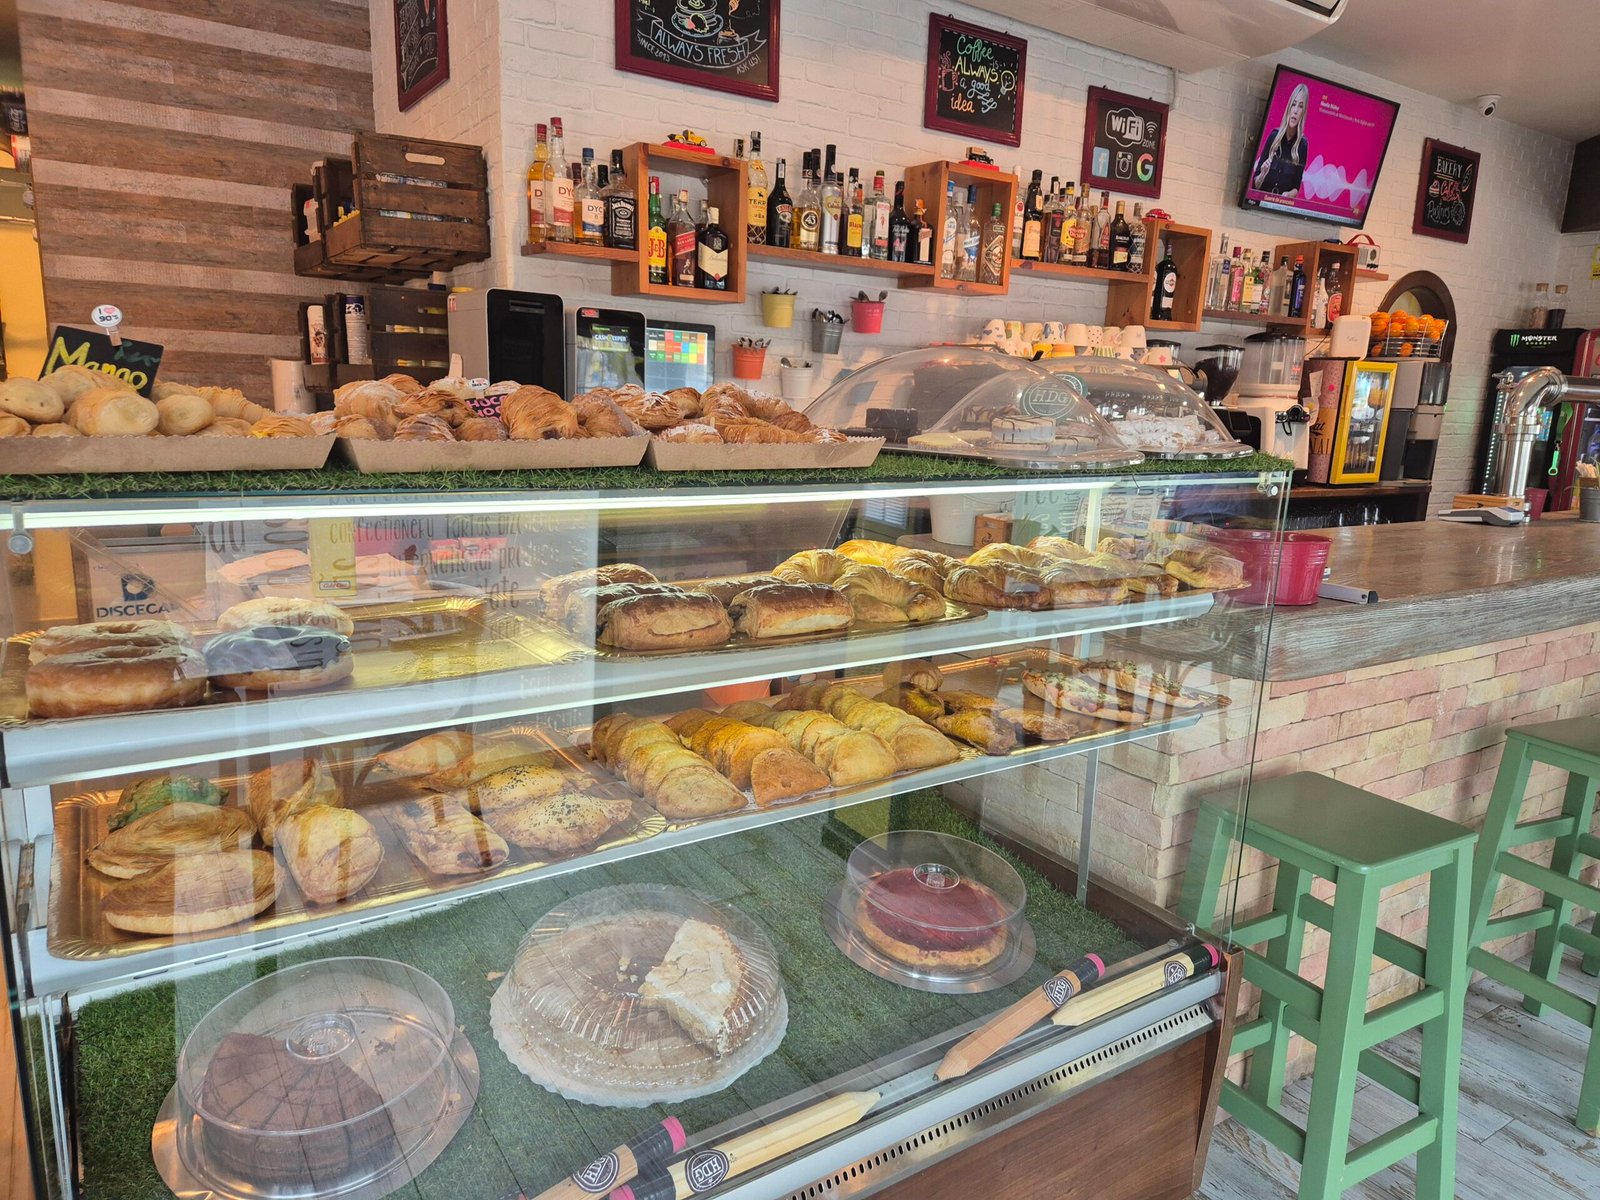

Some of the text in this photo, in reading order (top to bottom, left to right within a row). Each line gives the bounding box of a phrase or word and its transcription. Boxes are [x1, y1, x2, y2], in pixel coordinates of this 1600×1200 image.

[636, 33, 655, 55] SINCE
[654, 28, 746, 65] ALWAYS FRESH
[956, 36, 994, 63] Coffee
[736, 64, 749, 74] ASK
[955, 56, 998, 83] ALWAYS
[960, 77, 991, 98] a good
[951, 93, 975, 113] idea
[1111, 113, 1141, 137] WiFi
[558, 186, 574, 197] DY
[804, 214, 816, 225] 43
[1521, 334, 1558, 342] MONSTER
[1032, 389, 1069, 403] HDG
[1053, 979, 1068, 1003] HDG
[694, 1156, 723, 1182] HDG
